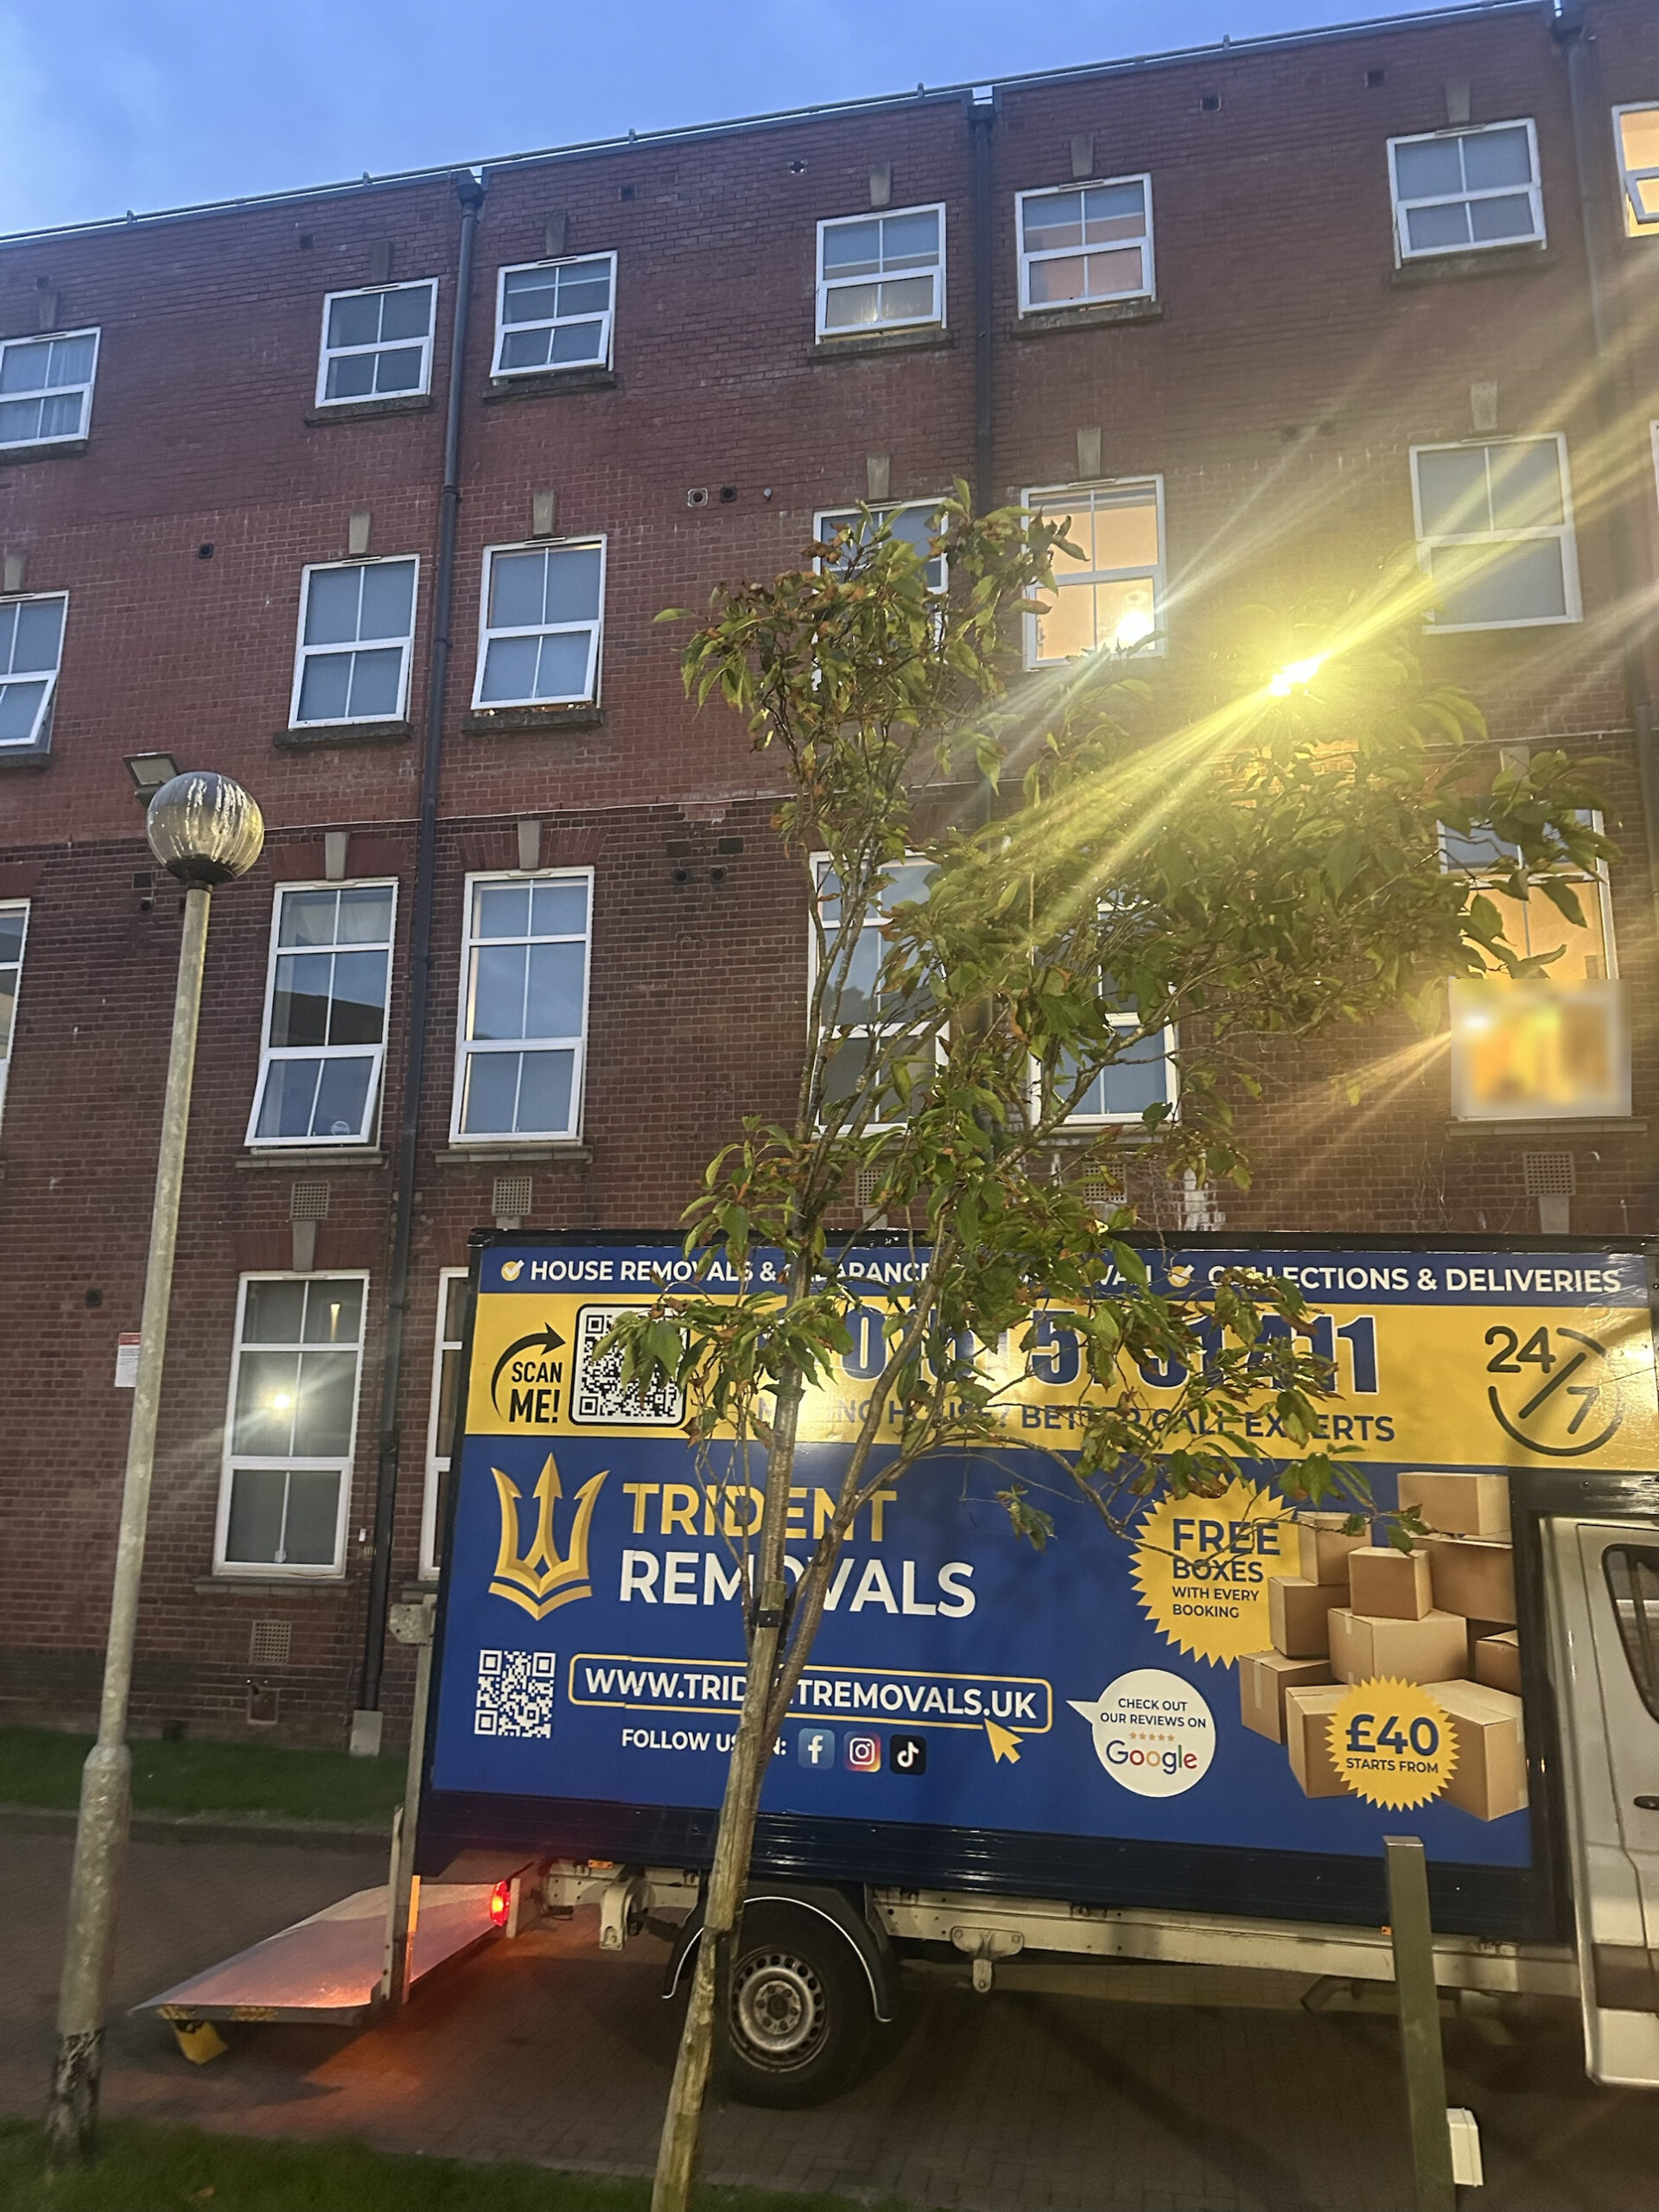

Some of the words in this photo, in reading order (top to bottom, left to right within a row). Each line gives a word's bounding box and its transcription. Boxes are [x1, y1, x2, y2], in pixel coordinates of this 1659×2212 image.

[531, 1260, 613, 1281] HOUSE
[760, 1261, 777, 1282] &
[1208, 1265, 1409, 1291] CECTIONS
[1417, 1268, 1438, 1291] &
[1446, 1268, 1621, 1294] DELIVERIES
[512, 1361, 563, 1382] SCAN
[509, 1389, 561, 1423] ME!
[1245, 1411, 1395, 1442] EXERTS
[623, 1483, 897, 1541] TRIDENT
[1173, 1518, 1281, 1555] FREE
[620, 1549, 976, 1618] REMVALS
[1173, 1556, 1264, 1583] BOXES
[1172, 1586, 1210, 1599] WITH
[1214, 1588, 1260, 1601] EVERY
[1173, 1604, 1240, 1618] BOOKING
[585, 1668, 1037, 1719] WWW.TRIDTREMOVALS.UK
[1118, 1698, 1160, 1710] CHECK
[1162, 1700, 1188, 1712] OUT
[1100, 1713, 1127, 1724] OUR
[1130, 1714, 1185, 1727] REVIEWS
[1187, 1718, 1206, 1728] ON
[622, 1729, 710, 1751] FOLLOW
[1345, 1713, 1440, 1757] £40
[1106, 1739, 1198, 1775] Google
[1346, 1758, 1395, 1771] STARTS
[1400, 1761, 1439, 1773] FROM
